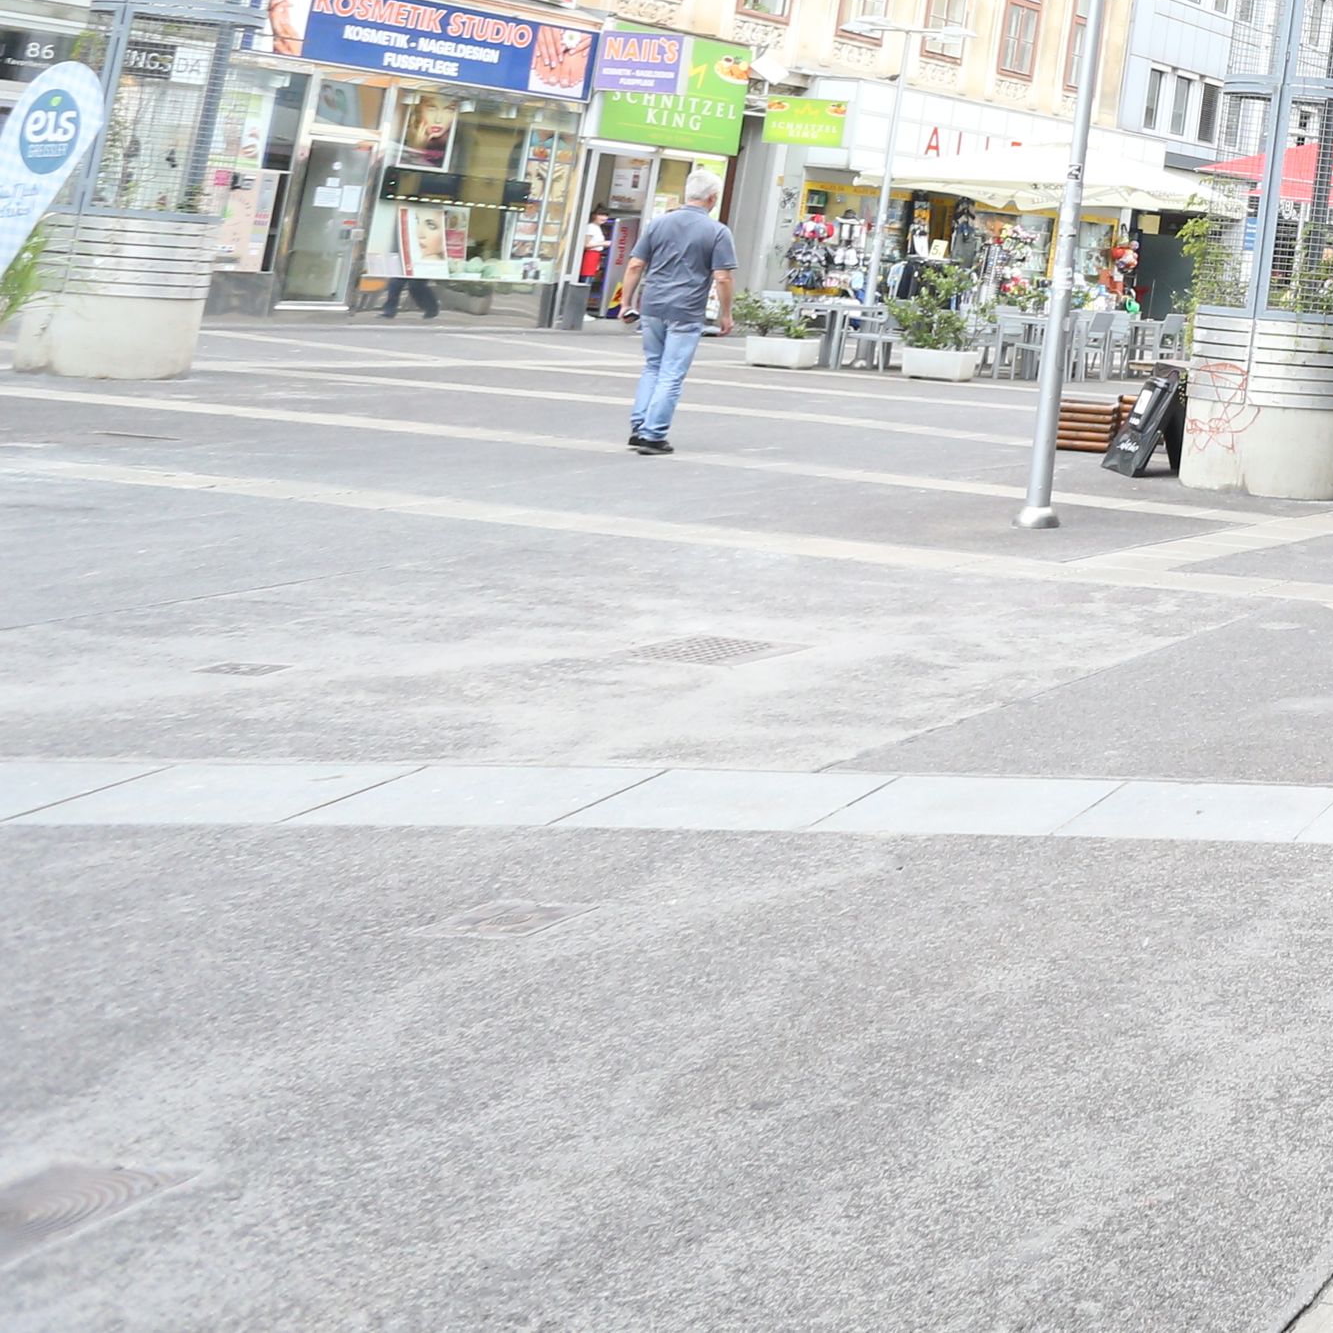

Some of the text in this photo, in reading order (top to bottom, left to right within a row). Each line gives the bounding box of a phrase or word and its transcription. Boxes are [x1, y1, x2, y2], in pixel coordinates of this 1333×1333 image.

[343, 25, 409, 49] KOSMETIK
[417, 37, 500, 63] NAGELDESIGN
[447, 12, 533, 49] STUDIO
[25, 42, 54, 59] 86
[383, 53, 459, 77] FUSSPFLEGE
[611, 90, 737, 120] SCHNITZEL
[646, 108, 702, 131] KING
[26, 110, 77, 143] eis
